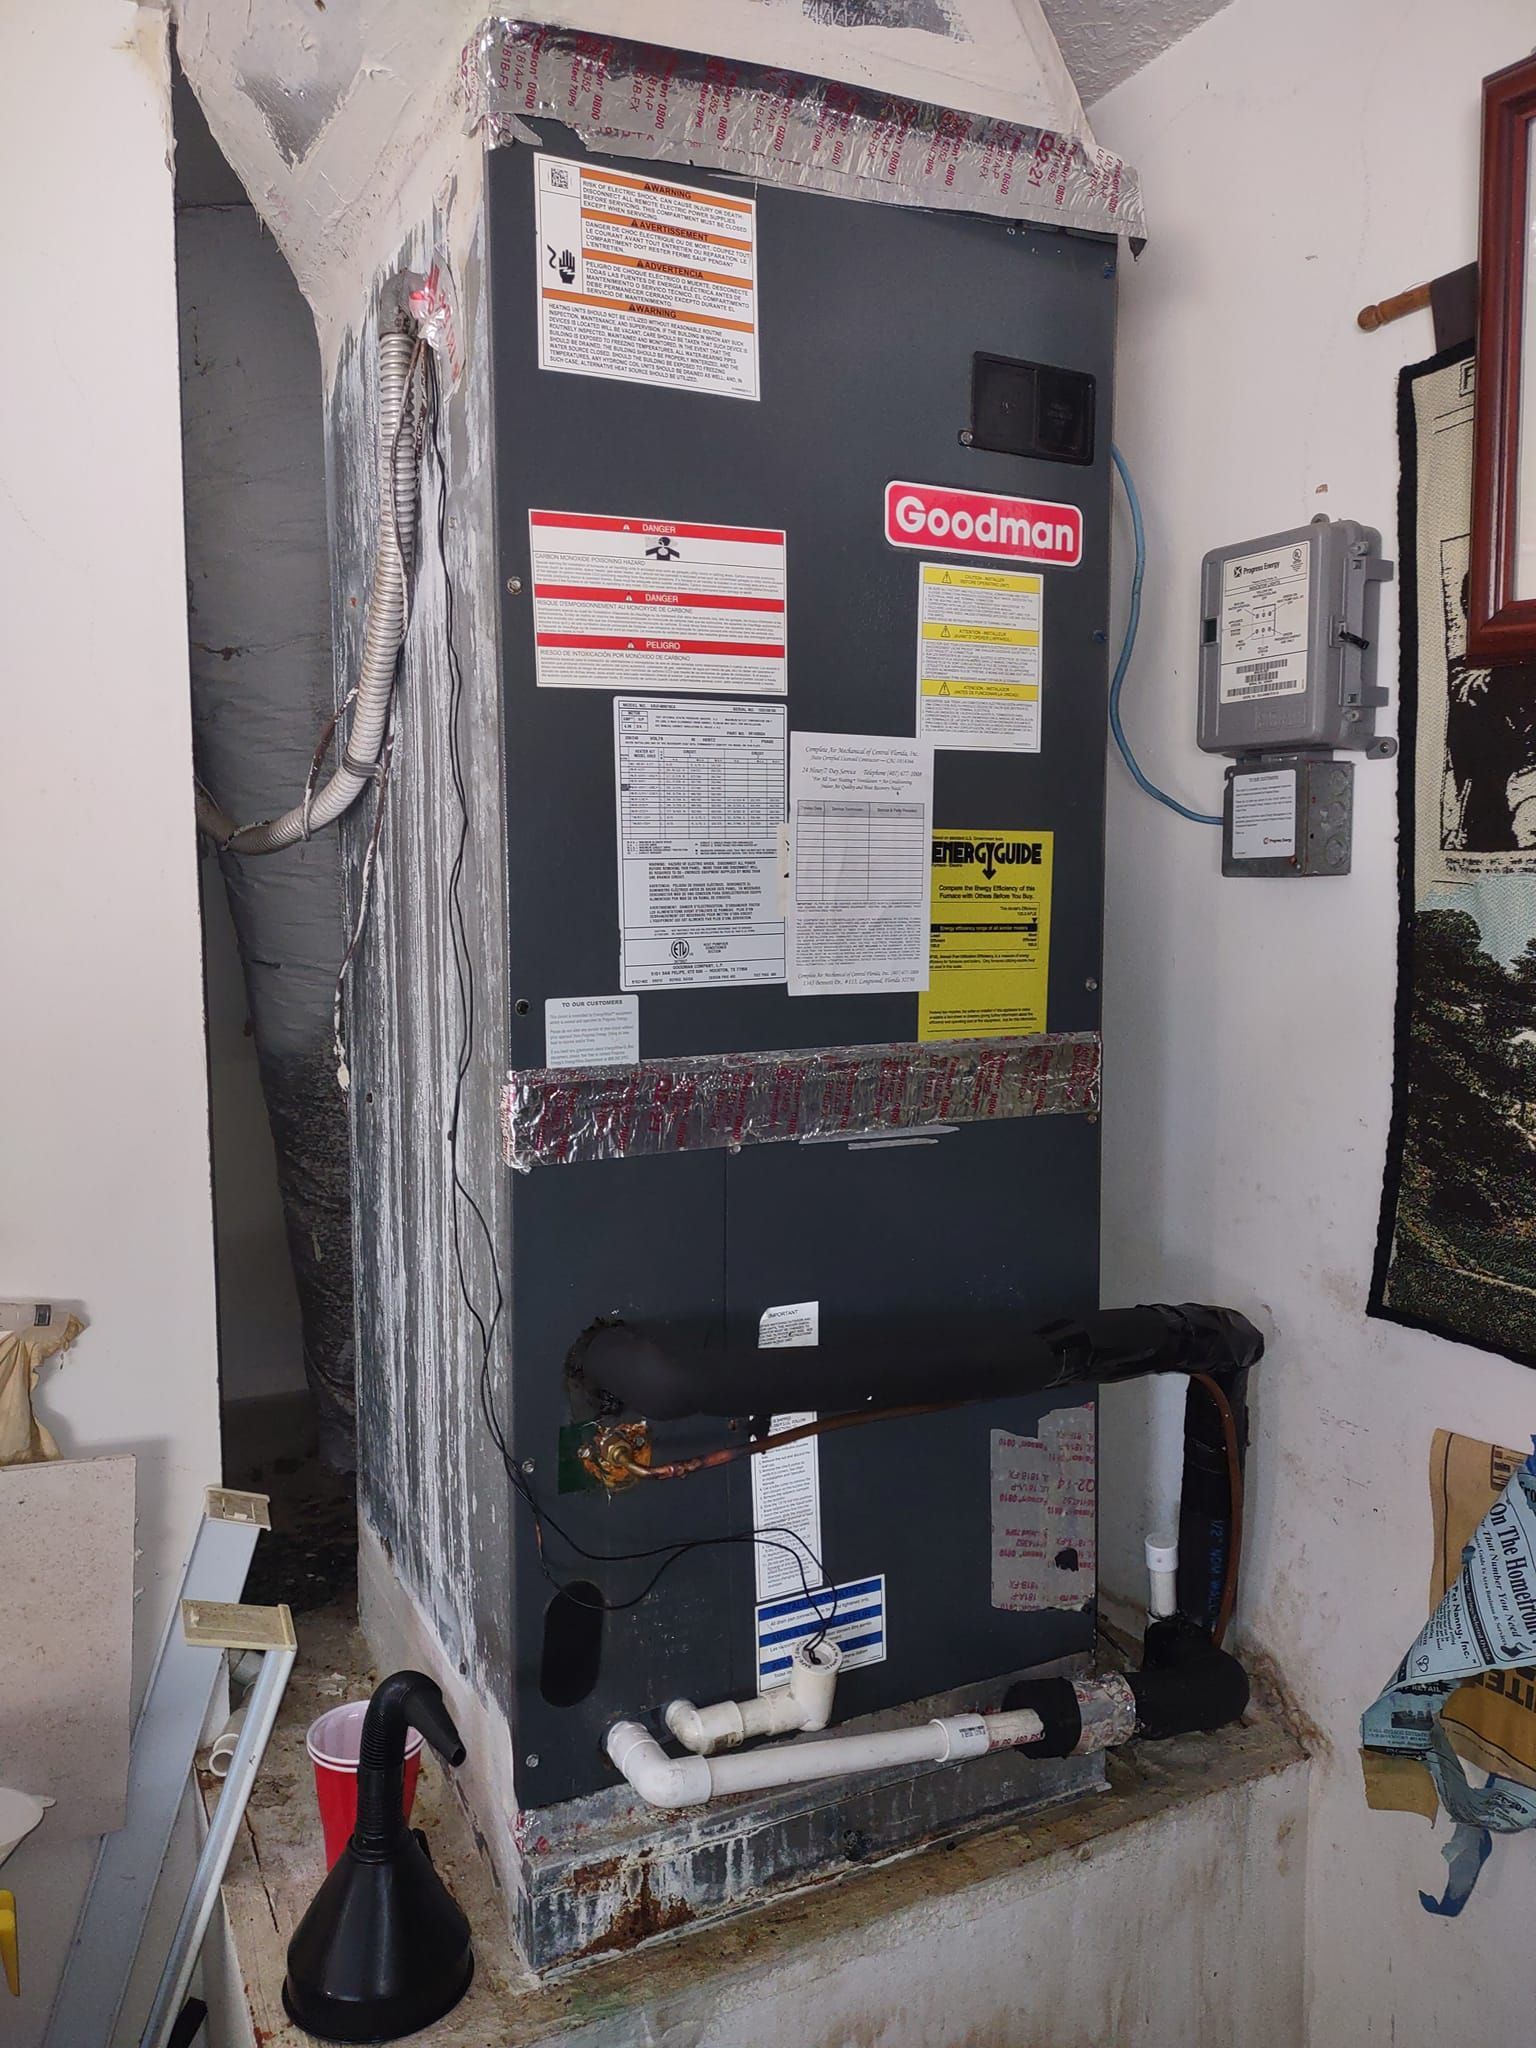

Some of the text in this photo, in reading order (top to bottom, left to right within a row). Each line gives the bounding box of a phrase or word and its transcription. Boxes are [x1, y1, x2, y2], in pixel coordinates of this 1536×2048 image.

[525, 81, 537, 109] 0800
[592, 94, 603, 121] 0800
[655, 102, 667, 130] 0800
[716, 116, 728, 141] 0800
[774, 125, 786, 151] 0800
[831, 140, 843, 164] 0800
[888, 151, 900, 176] 0800
[1027, 133, 1056, 188] Q2-21
[945, 163, 956, 186] 0800
[582, 180, 596, 188] RISK
[607, 185, 636, 197] ELECTRIC
[673, 199, 691, 208] CAUSE
[693, 204, 713, 213] INJURY
[649, 184, 691, 200] WARNING
[1055, 185, 1065, 205] 0800
[582, 187, 620, 200] DISCONNECT
[634, 198, 657, 208] REMOTE
[659, 203, 686, 214] ELECTRIC
[687, 209, 708, 218] POWER
[709, 214, 735, 224] SUPPLIES
[583, 200, 606, 210] EXCEPT
[607, 205, 625, 214] WHEN
[583, 194, 607, 204] BEFORE
[642, 206, 655, 214] THIS
[656, 209, 698, 222] COMPARTMENT
[700, 218, 715, 226] MUST
[585, 220, 610, 230] DANGER
[621, 228, 638, 236] CHOC
[712, 246, 735, 255] COUPEZ
[594, 229, 623, 240] COURANT
[624, 235, 644, 244] AVANT
[645, 239, 660, 247] TOUT
[661, 242, 692, 253] ENTRETIEN
[639, 220, 708, 242] AVERTISSEMENT
[585, 260, 612, 270] PELIGRO
[622, 267, 647, 276] CHOQUE
[585, 267, 606, 275] TODAS
[620, 273, 647, 283] FUENTES
[644, 261, 703, 279] ADVERTENCIA
[586, 287, 614, 296] SERVICIO
[637, 304, 676, 318] WARNING
[642, 523, 676, 534] DANGER
[895, 495, 1073, 552] Goodman
[1243, 560, 1280, 575] Progress Energy
[644, 593, 678, 603] DANGER
[645, 640, 680, 650] PELIGRO
[932, 841, 1042, 865] ENERGYGUIDE
[1489, 1503, 1508, 1526] On
[1498, 1525, 1521, 1556] The
[1483, 1531, 1522, 1637] That Number You Need
[1453, 1604, 1463, 1639] Nanny,
[1461, 1641, 1469, 1659] Inc.
